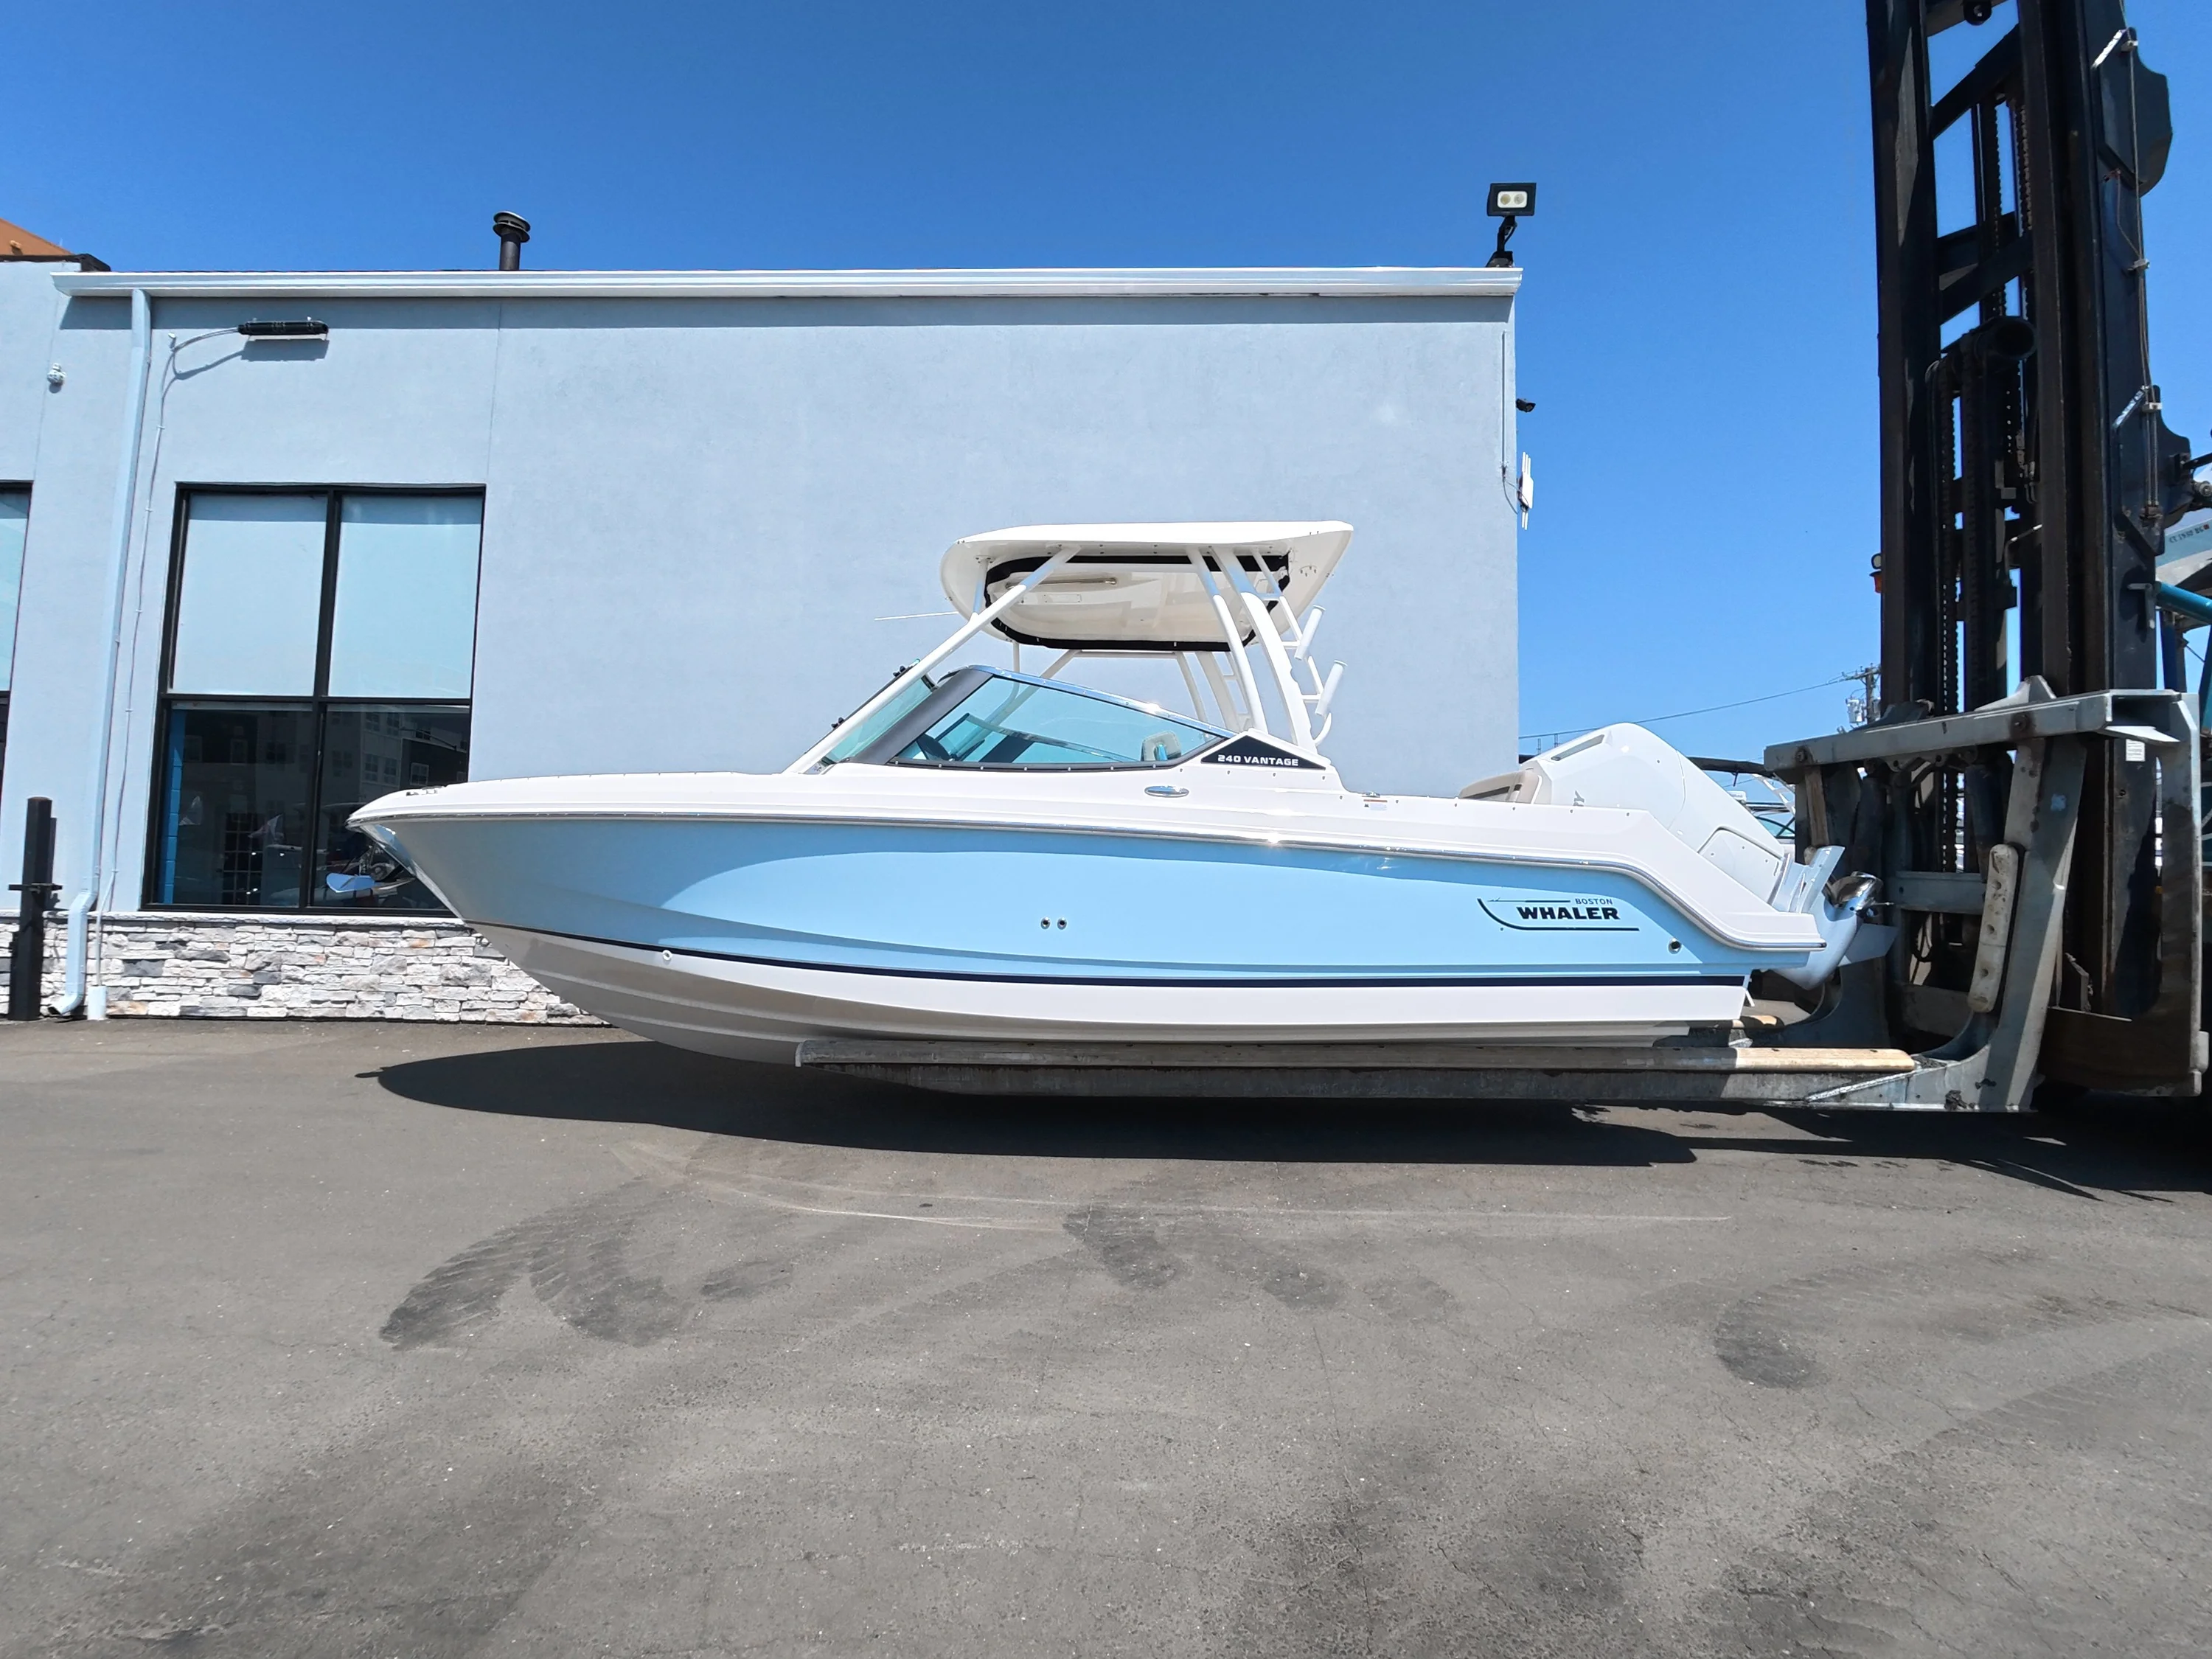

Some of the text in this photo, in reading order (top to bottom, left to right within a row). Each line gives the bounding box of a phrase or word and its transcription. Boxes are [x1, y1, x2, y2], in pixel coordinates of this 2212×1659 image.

[1217, 754, 1299, 766] 240 VANTAGE
[1516, 907, 1621, 920] WHALER
